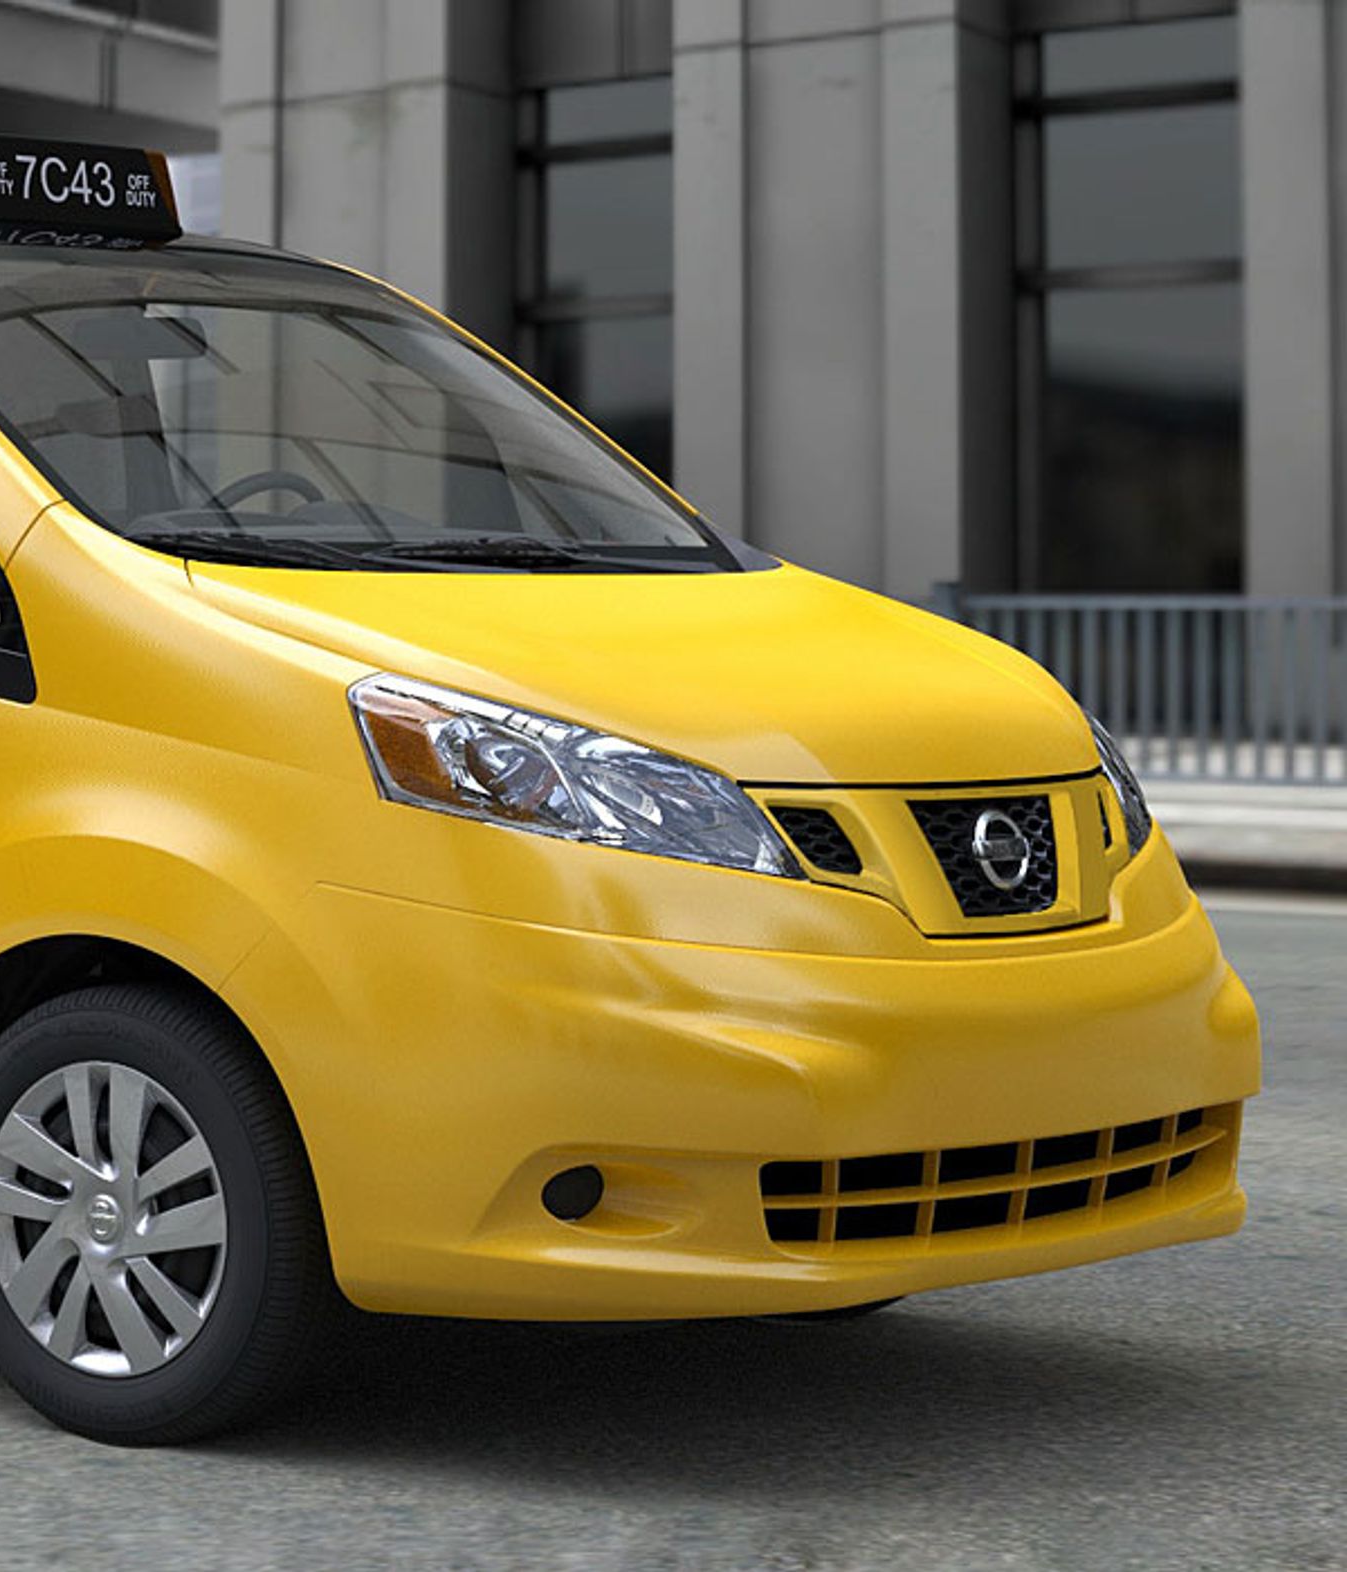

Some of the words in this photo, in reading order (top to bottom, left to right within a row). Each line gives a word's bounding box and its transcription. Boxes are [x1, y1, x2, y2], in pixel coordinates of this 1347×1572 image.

[16, 155, 116, 207] 7C43
[127, 174, 150, 190] OFF
[126, 190, 156, 207] DUTY
